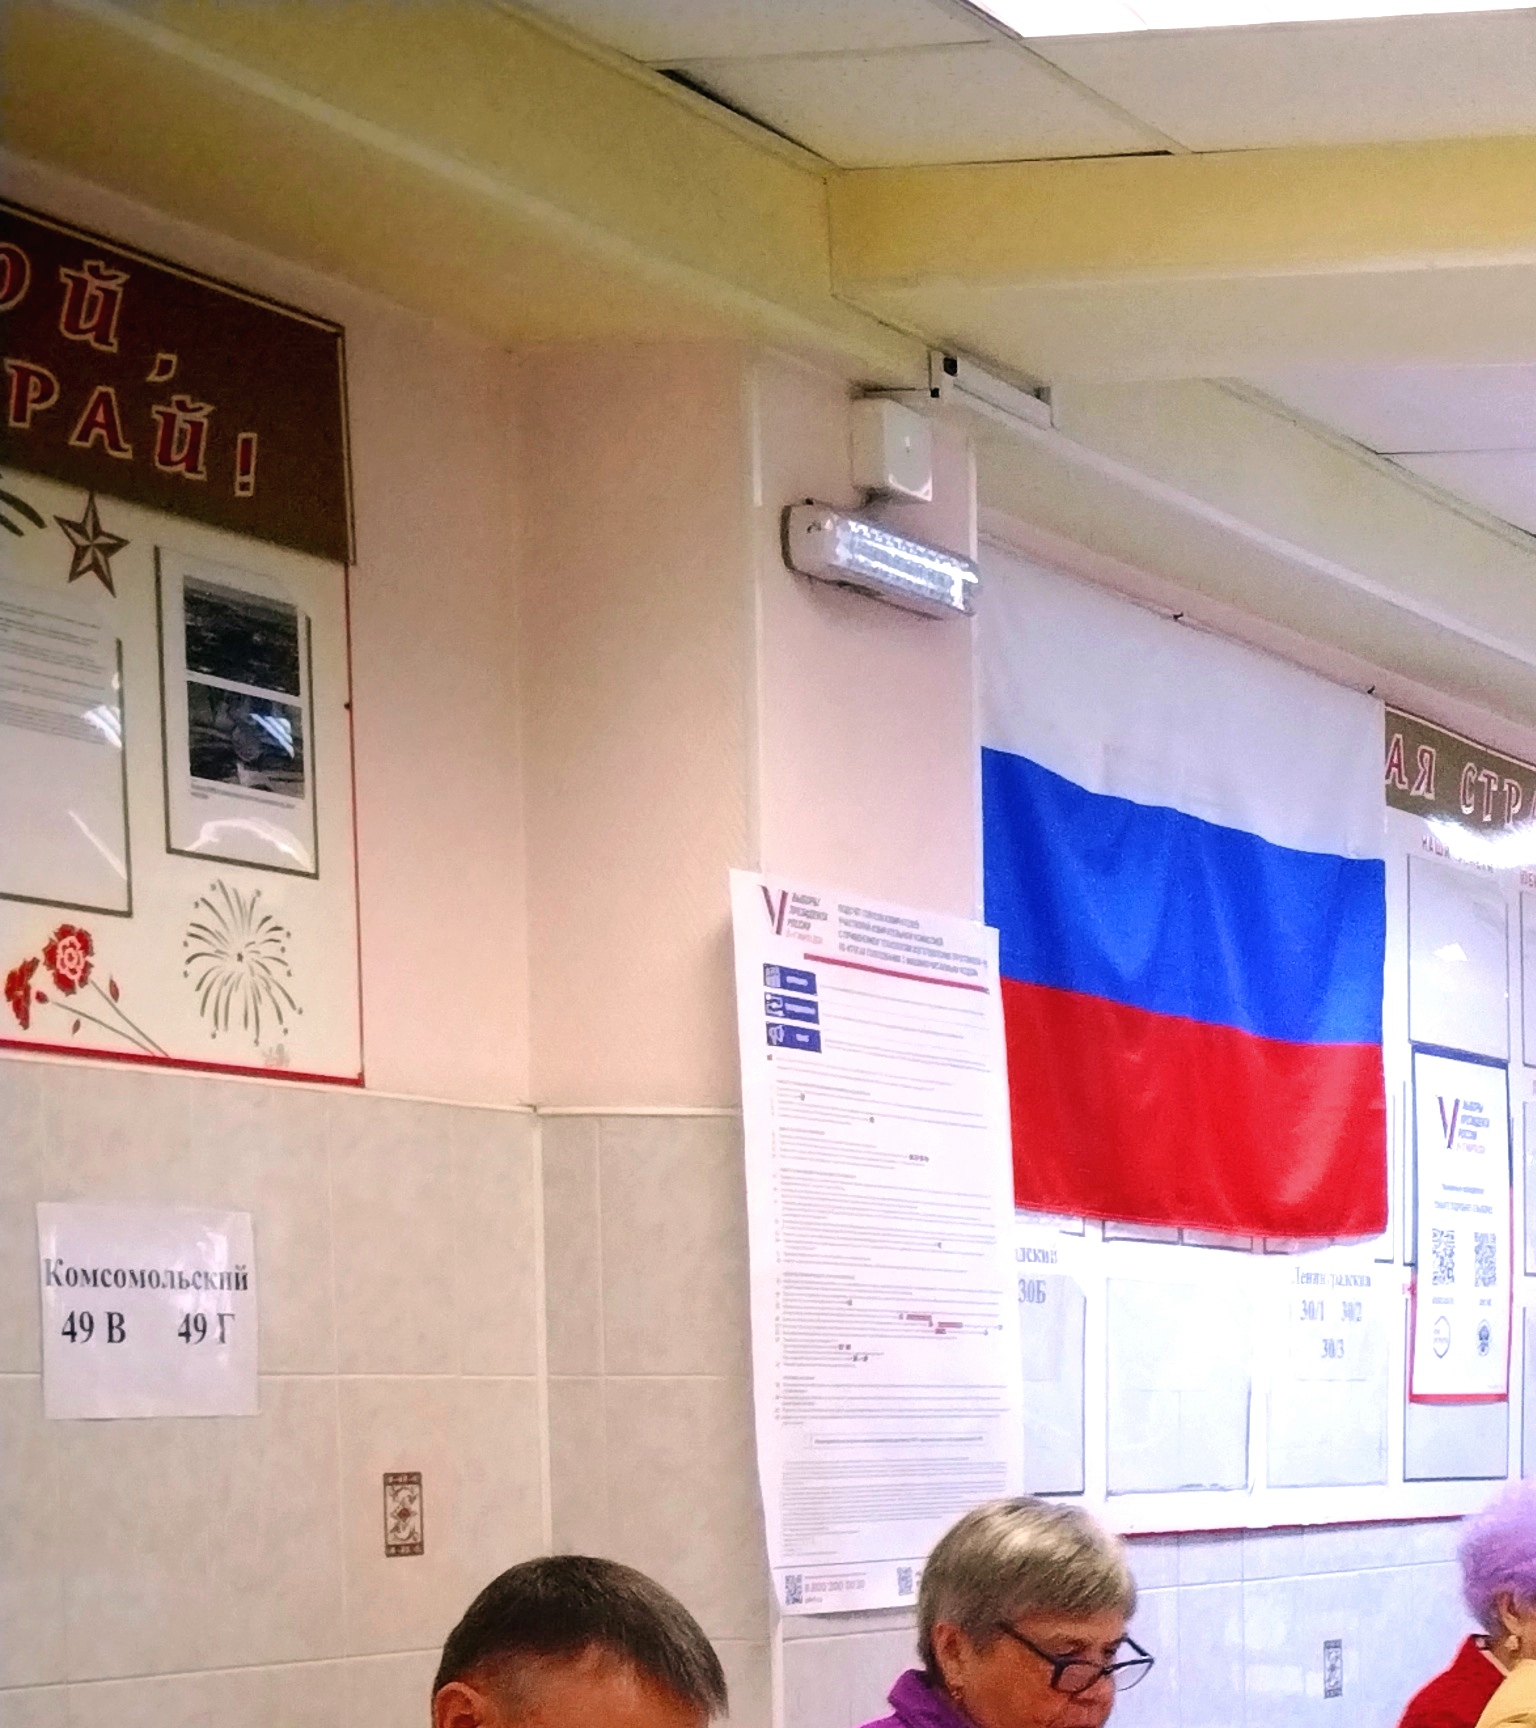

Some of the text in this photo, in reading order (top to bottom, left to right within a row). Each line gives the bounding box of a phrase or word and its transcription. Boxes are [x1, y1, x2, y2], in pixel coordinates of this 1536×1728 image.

[43, 1257, 249, 1292] Комсомольский
[61, 1311, 126, 1344] 49 В
[177, 1312, 236, 1345] 49 Г
